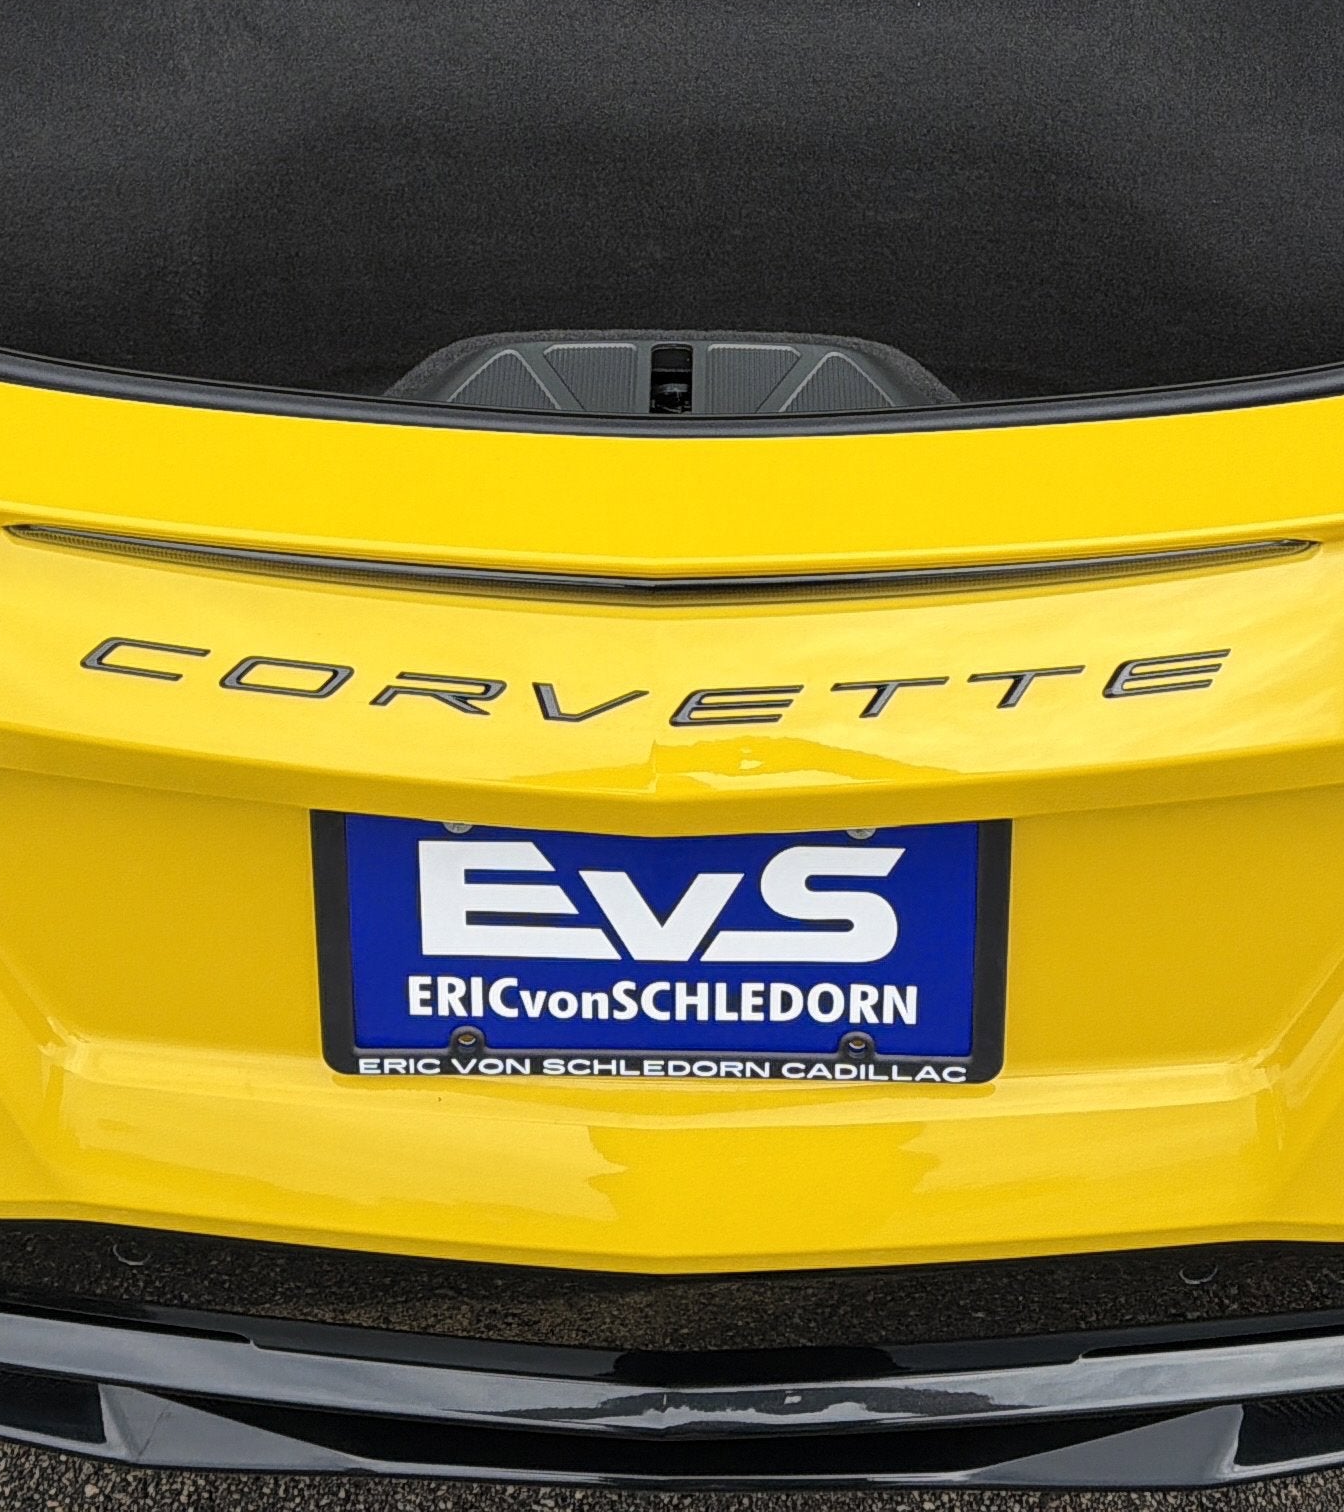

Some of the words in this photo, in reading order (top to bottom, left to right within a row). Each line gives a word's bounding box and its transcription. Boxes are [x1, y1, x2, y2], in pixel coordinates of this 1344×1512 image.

[80, 636, 1231, 728] CORVETTE
[408, 975, 918, 1025] ERICvonSCHLEDORN
[358, 1057, 441, 1075] ERIC
[450, 1057, 531, 1075] VON
[542, 1058, 771, 1078] SCHLEDORN
[781, 1062, 967, 1083] CADILLAC
